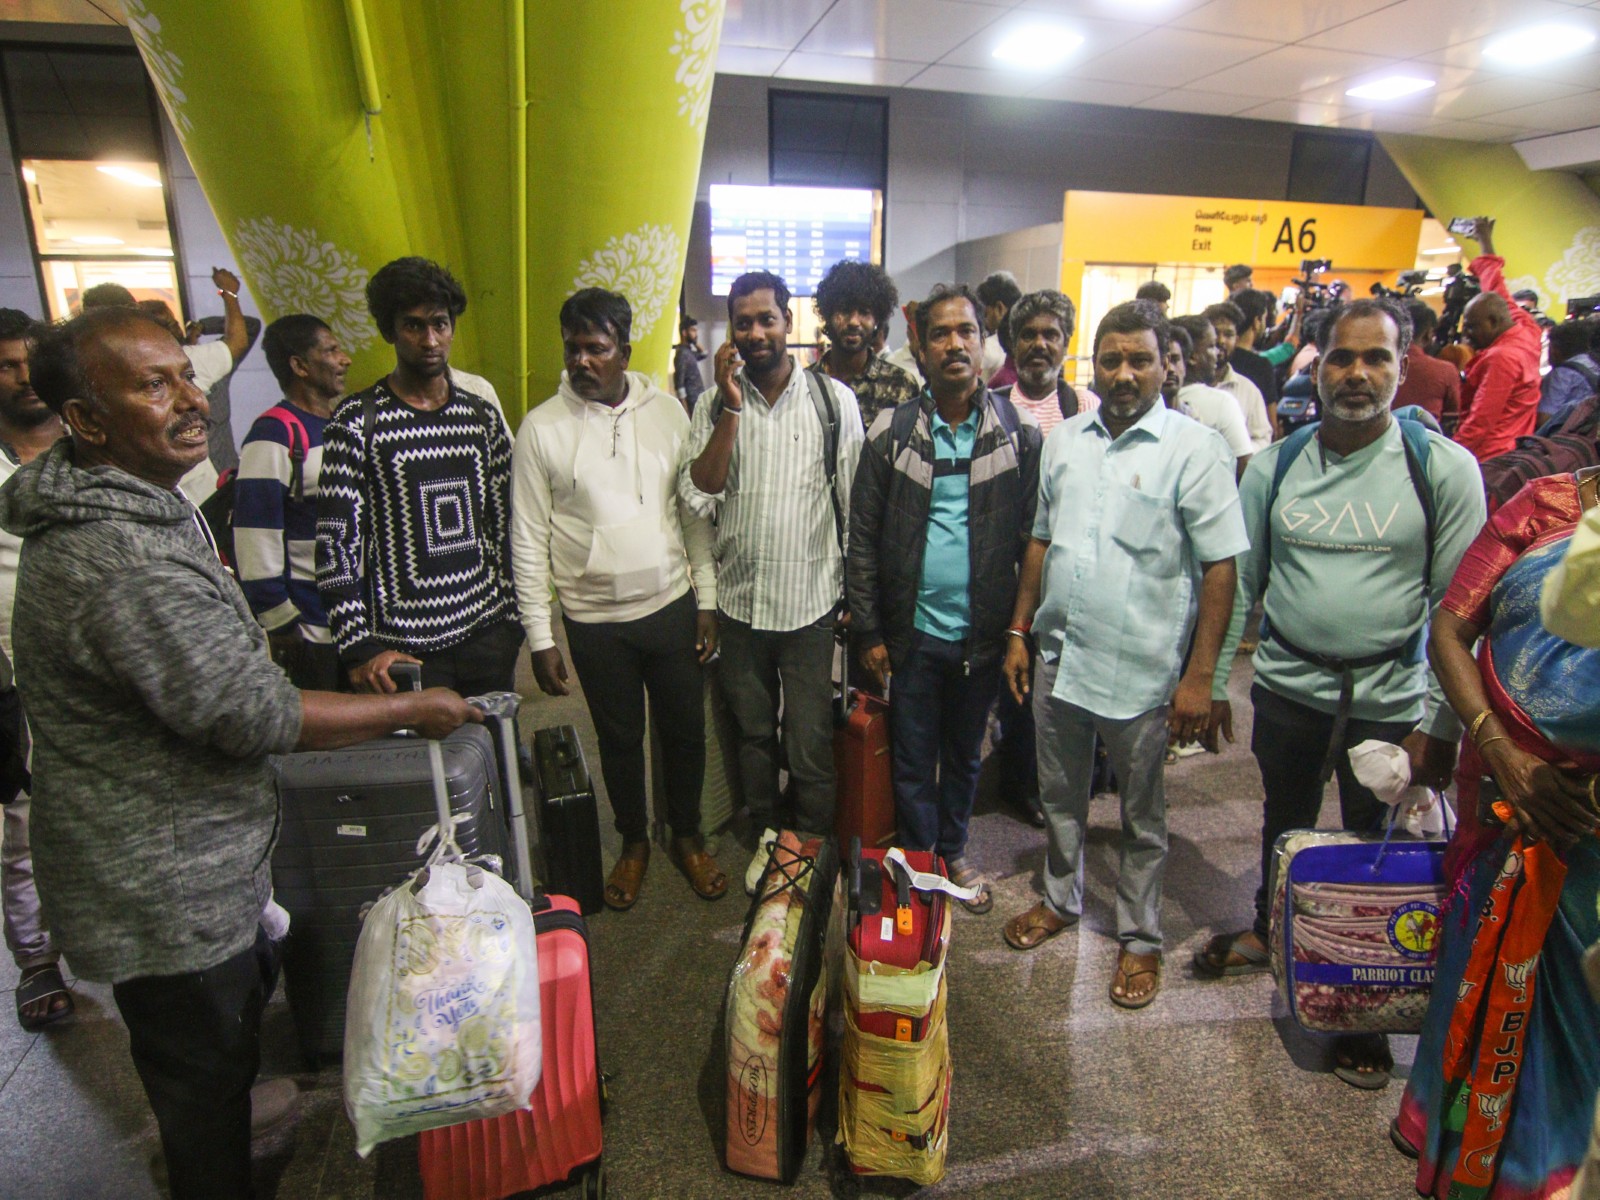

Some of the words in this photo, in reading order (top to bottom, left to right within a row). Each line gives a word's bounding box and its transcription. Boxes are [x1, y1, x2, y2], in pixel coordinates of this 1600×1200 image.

[1272, 216, 1316, 253] A6
[1192, 239, 1211, 251] Exit
[1352, 968, 1406, 982] PARRIOT
